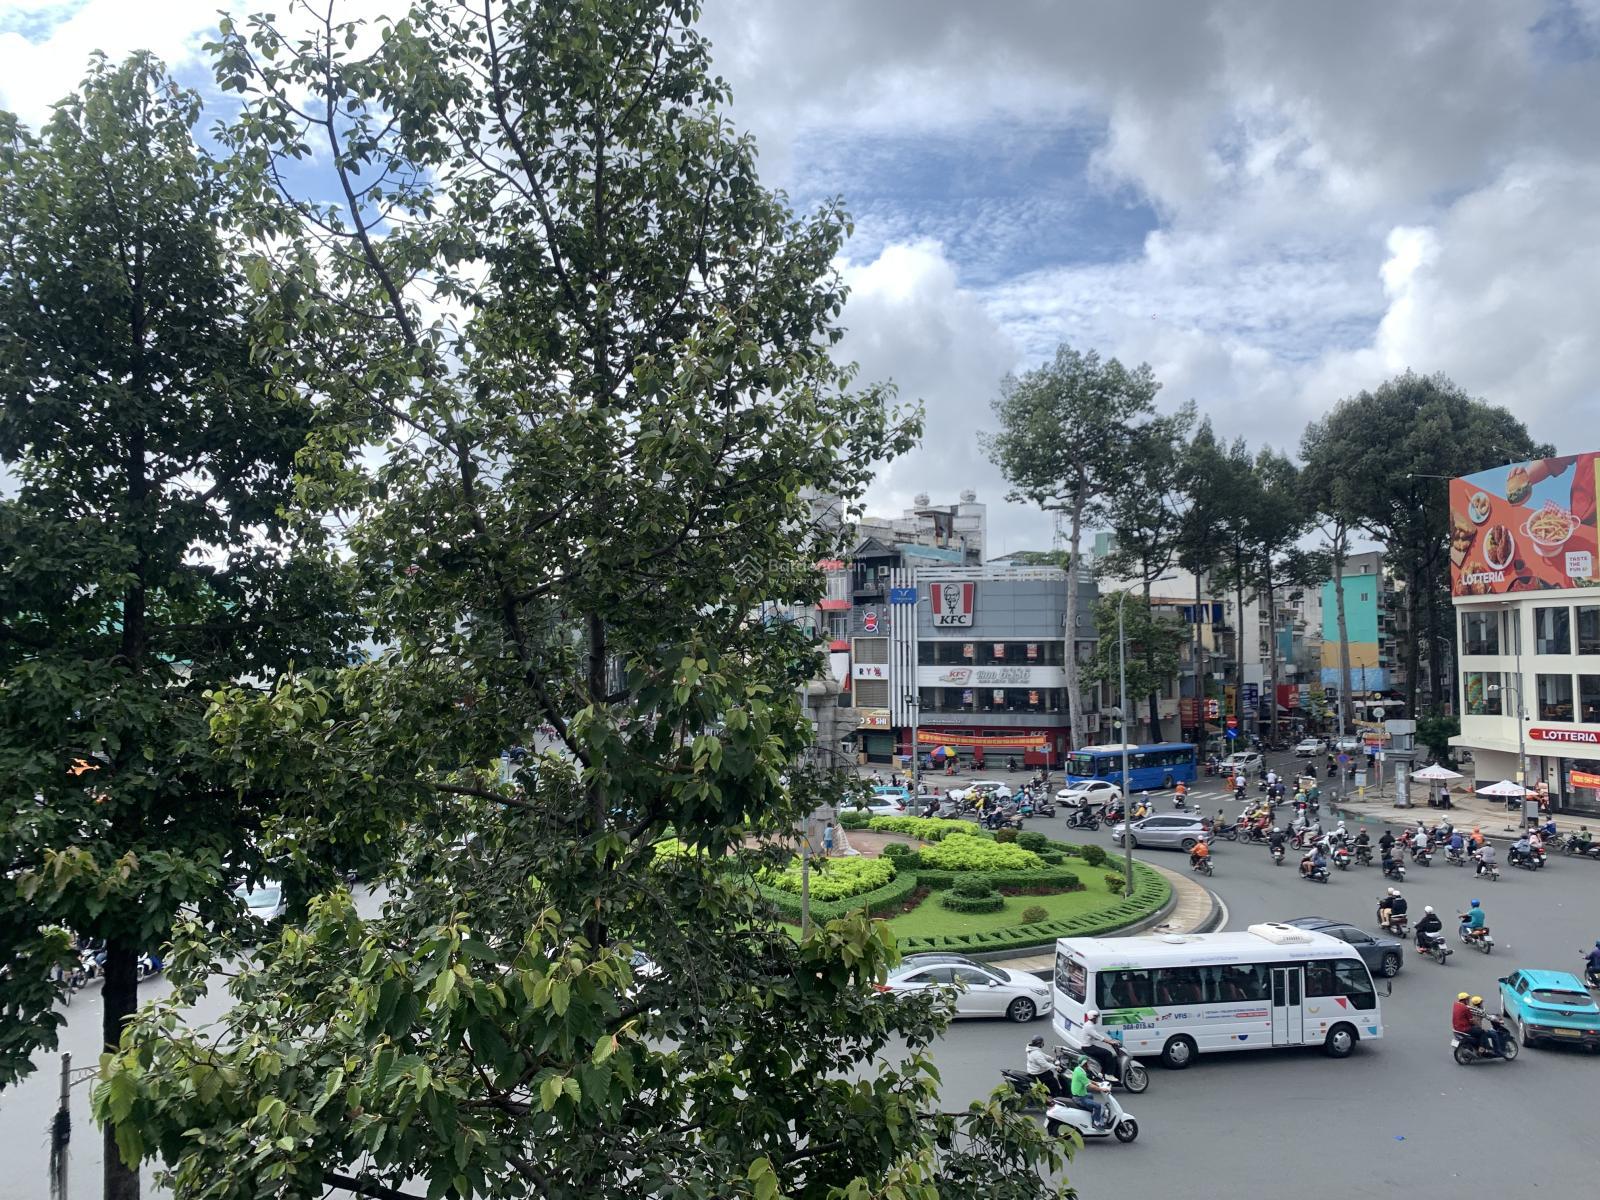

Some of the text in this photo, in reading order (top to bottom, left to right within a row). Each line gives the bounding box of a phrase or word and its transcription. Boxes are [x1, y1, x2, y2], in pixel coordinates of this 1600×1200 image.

[1461, 571, 1505, 586] LOTTERIA
[939, 614, 967, 625] KFC
[1062, 614, 1082, 627] KC
[949, 670, 967, 678] KFC
[1542, 730, 1598, 742] LOTTERIA
